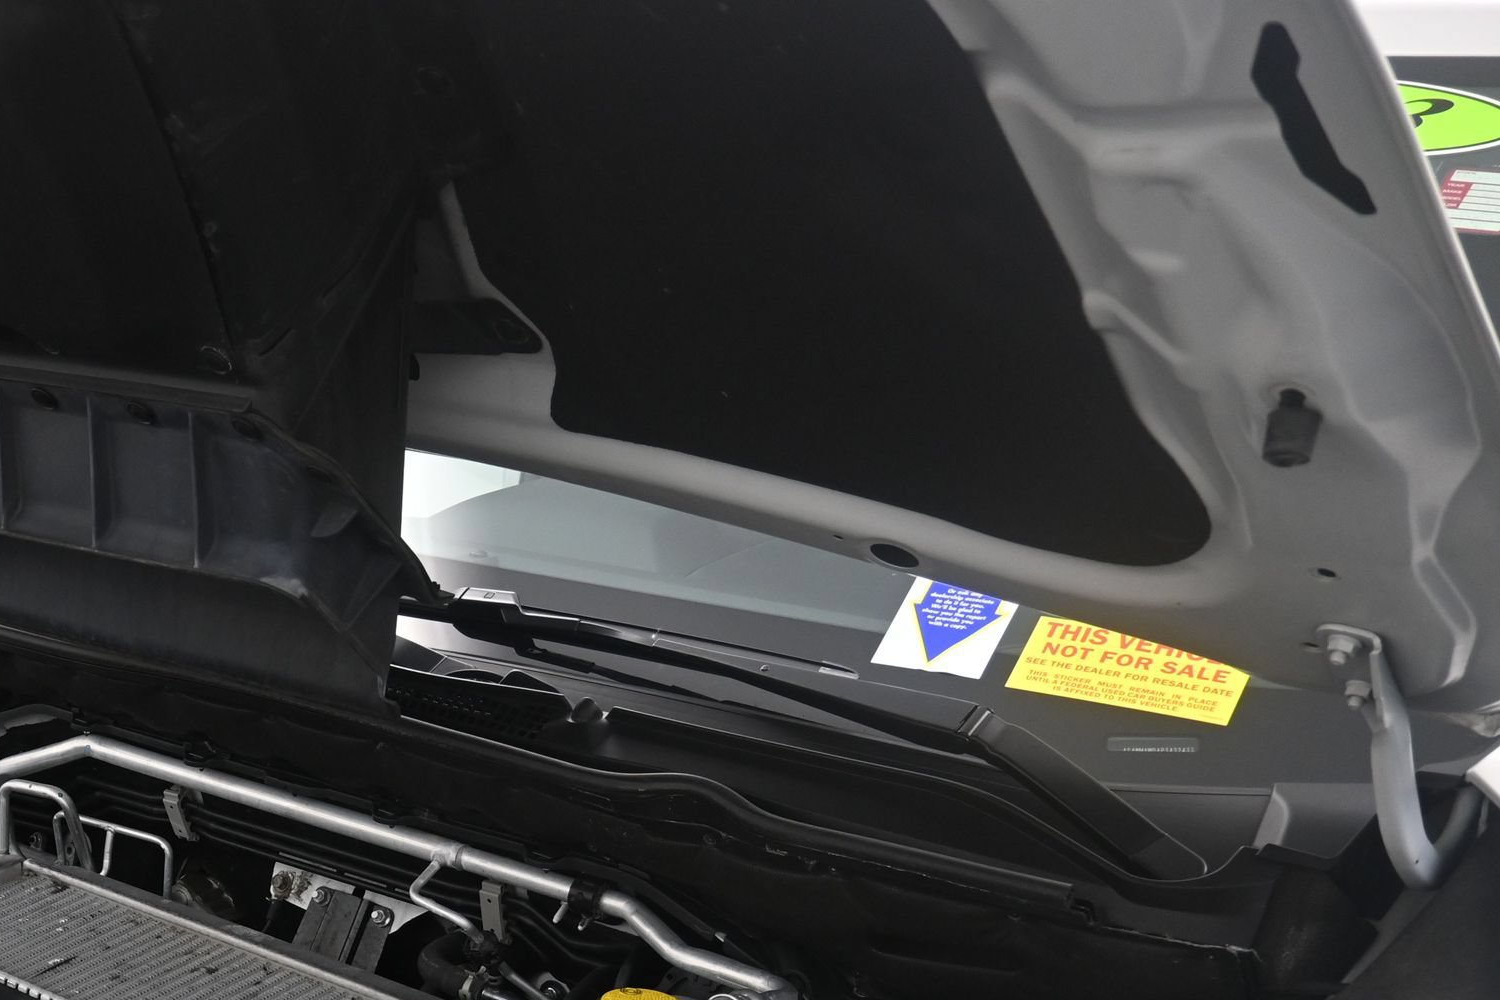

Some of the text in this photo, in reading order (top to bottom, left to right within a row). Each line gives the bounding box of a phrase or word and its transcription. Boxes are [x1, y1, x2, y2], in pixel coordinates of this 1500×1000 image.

[1046, 622, 1110, 646] THIS
[1026, 656, 1234, 698] SEE THE DEALER FOR RESALE DATE
[1042, 642, 1230, 684] NOT FOR SALE
[1026, 675, 1049, 684] UNTIL
[1060, 680, 1099, 692] FEDERAL
[1102, 687, 1126, 696] USED
[1127, 691, 1146, 699] CAR
[1148, 696, 1184, 706] BUYERS
[1186, 702, 1216, 712] GUIDE
[1054, 673, 1092, 684] STICKER
[1098, 680, 1122, 690] MUST
[1129, 686, 1166, 696] REMAIN
[1188, 696, 1218, 706] PLACE
[1064, 688, 1101, 698] AFFIXED
[1116, 696, 1137, 704] THIS
